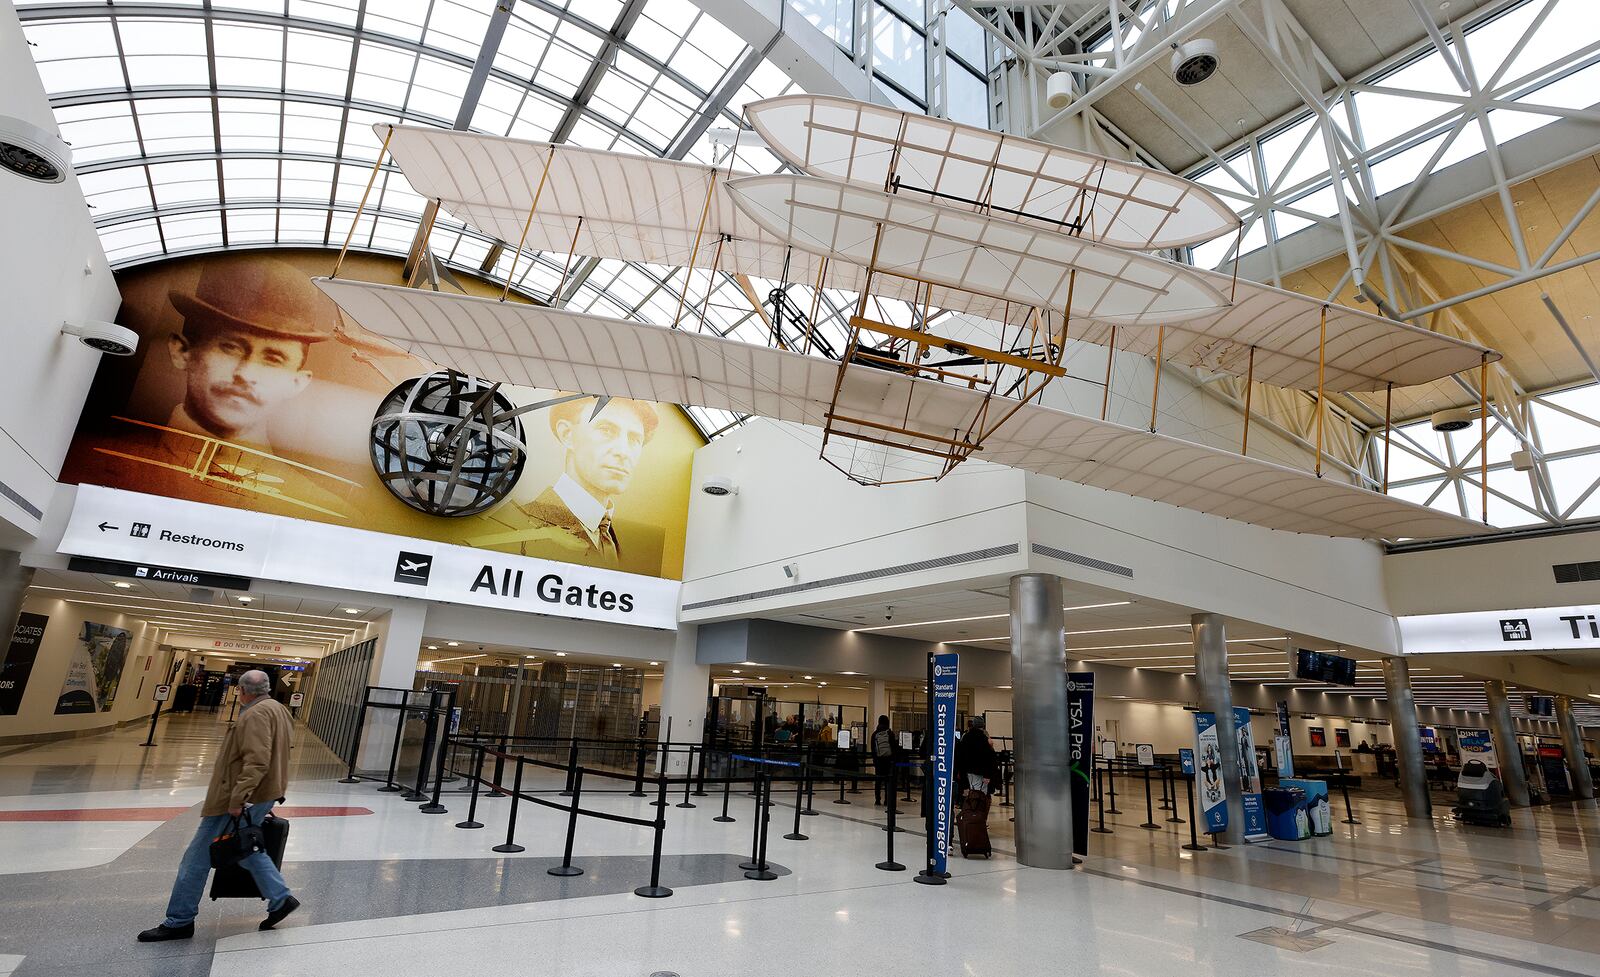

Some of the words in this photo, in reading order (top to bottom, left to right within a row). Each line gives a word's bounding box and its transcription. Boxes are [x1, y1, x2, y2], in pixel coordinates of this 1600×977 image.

[159, 530, 245, 552] Restrooms
[153, 570, 199, 583] Arrivals
[470, 564, 523, 598] All
[536, 574, 634, 612] Gates
[1560, 615, 1600, 639] Ti
[0, 680, 15, 689] ORS
[1070, 699, 1083, 729] TSA
[938, 704, 947, 772] Standard
[1071, 733, 1083, 760] Pre
[1460, 730, 1479, 738] DINE
[937, 777, 947, 858] Passenger
